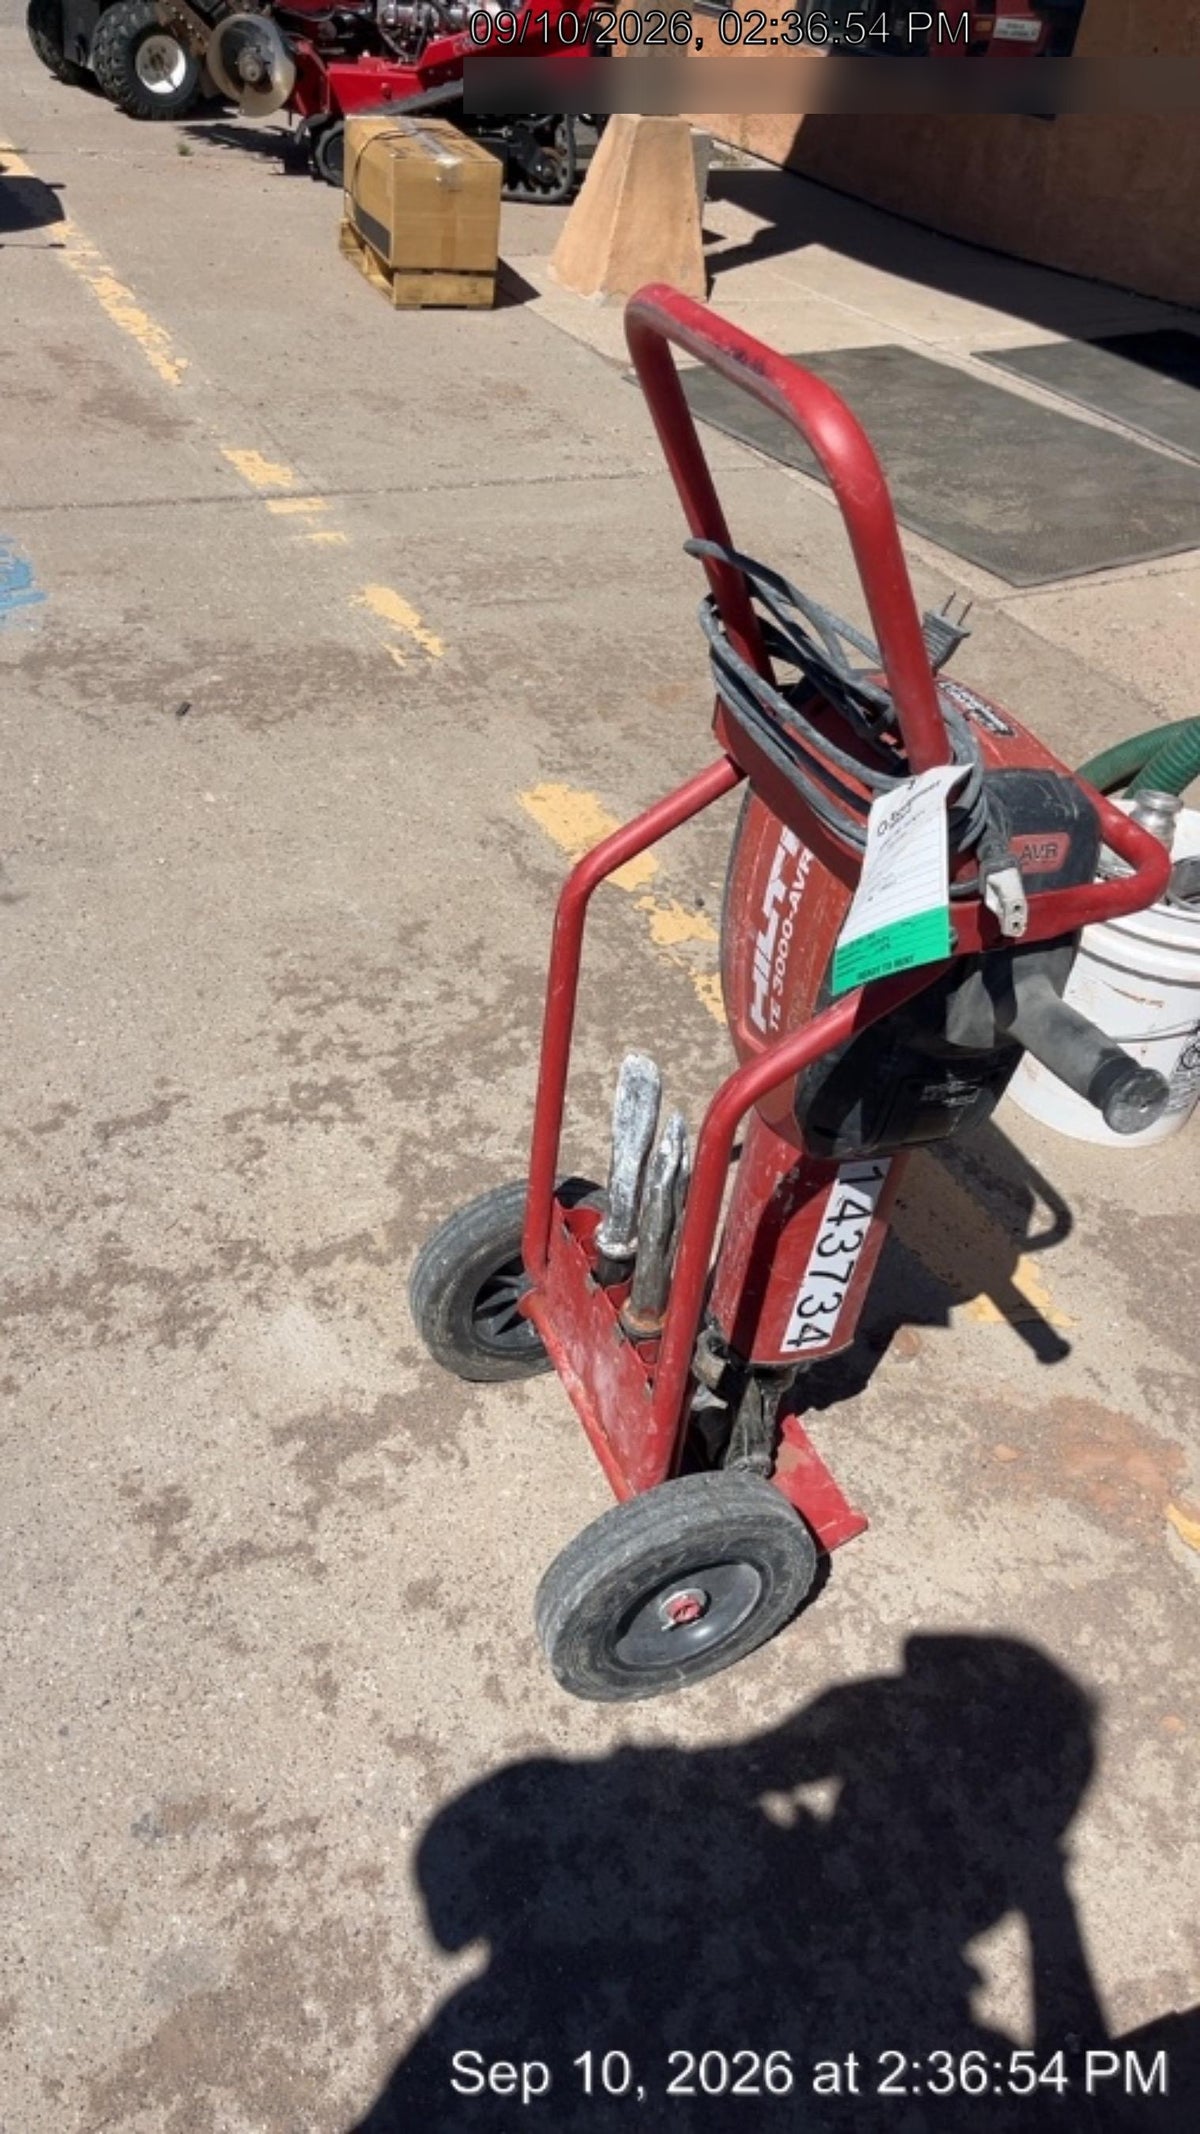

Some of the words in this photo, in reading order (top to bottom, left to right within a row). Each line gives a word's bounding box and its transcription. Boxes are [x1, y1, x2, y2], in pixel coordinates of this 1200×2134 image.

[1021, 843, 1058, 861] AVR
[751, 824, 801, 1034] HILTI
[769, 997, 781, 1031] TE
[786, 1165, 885, 1348] 143734
